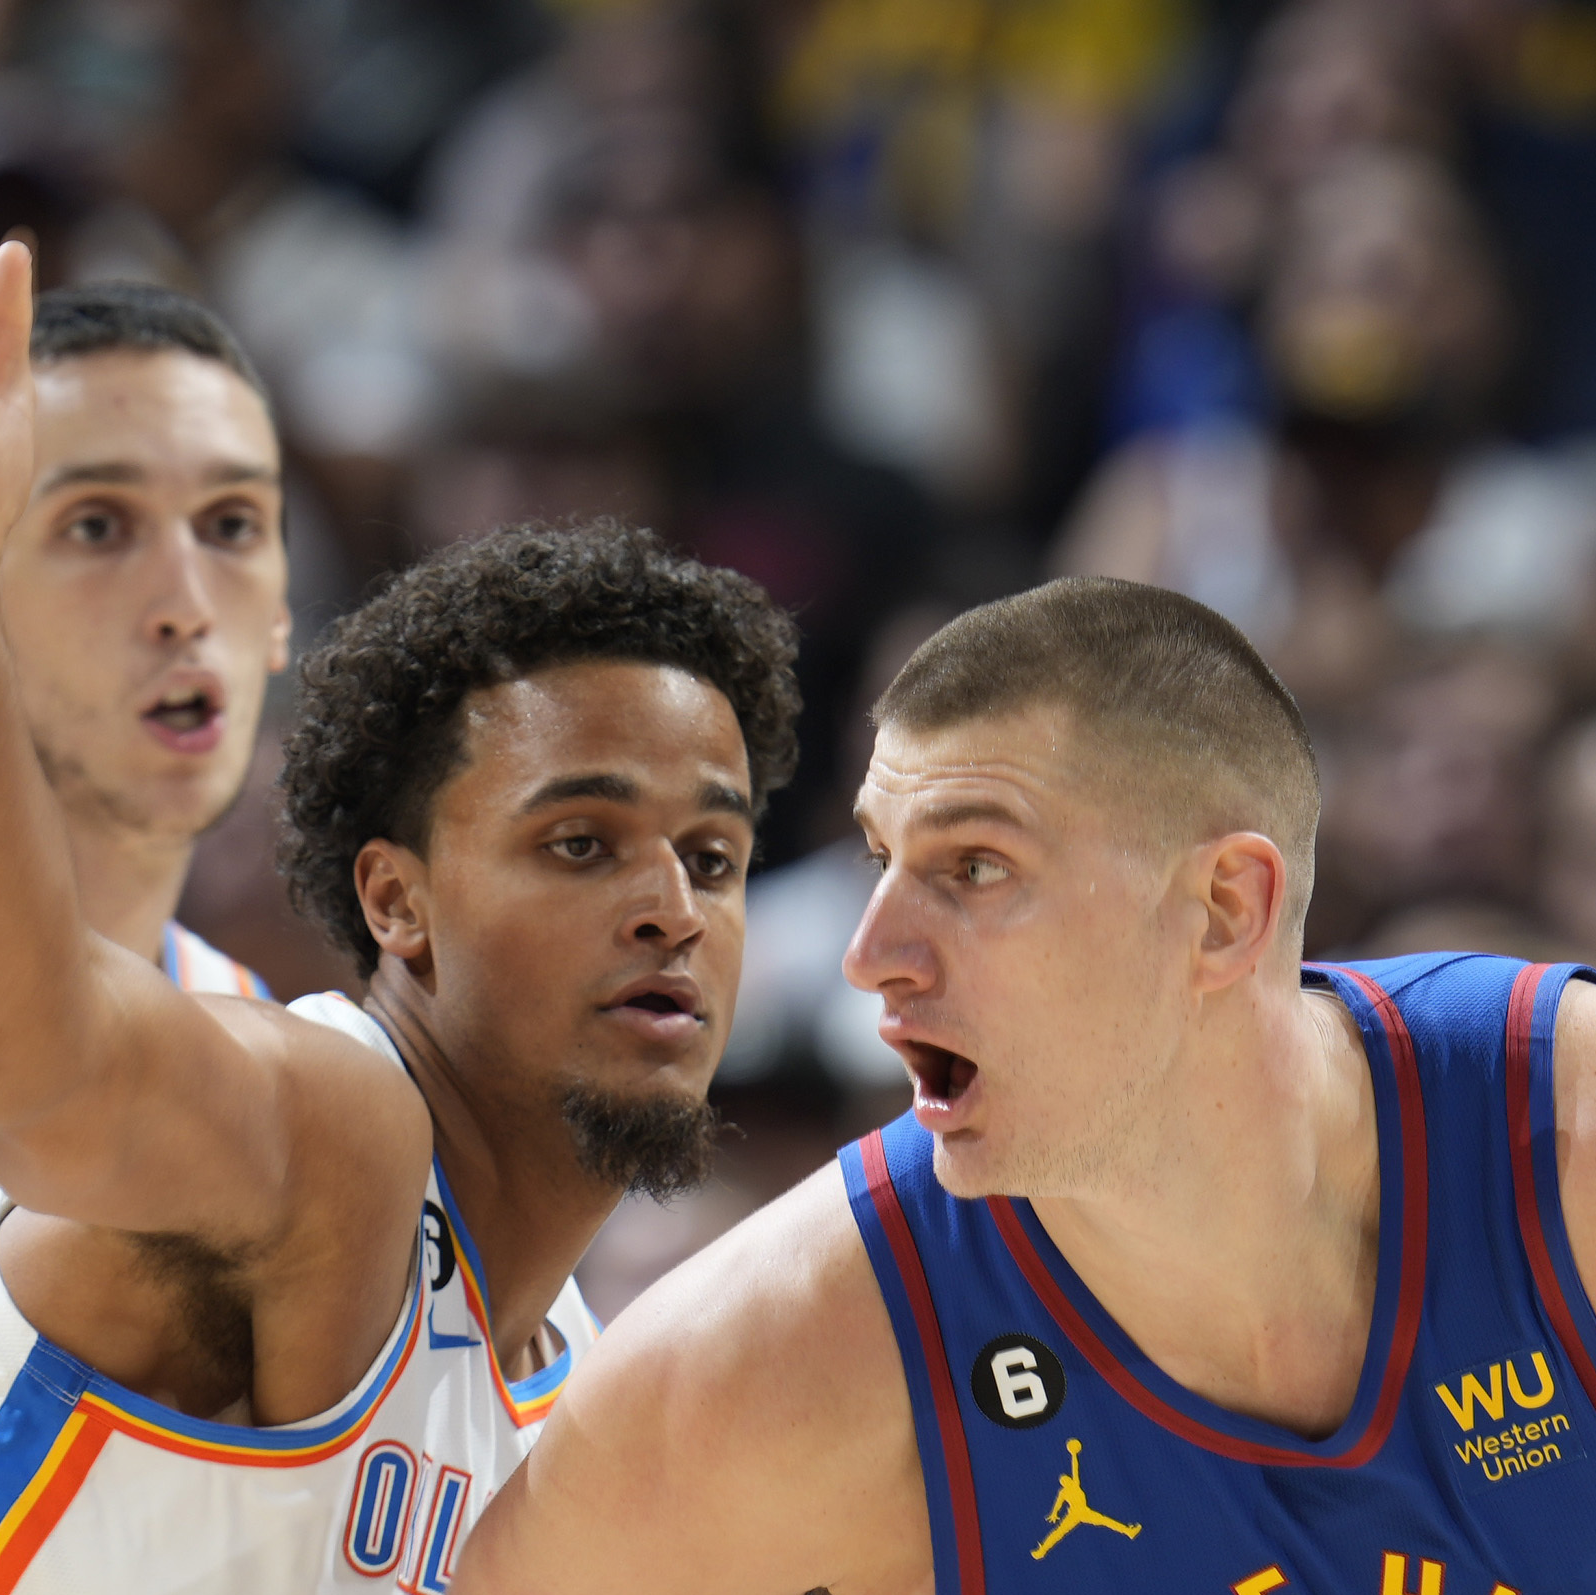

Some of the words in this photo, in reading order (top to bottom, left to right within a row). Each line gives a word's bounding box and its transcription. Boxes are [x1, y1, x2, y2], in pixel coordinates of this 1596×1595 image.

[991, 1345, 1048, 1418] 6
[1437, 1352, 1555, 1432] WU
[1455, 1415, 1570, 1463] Western
[1483, 1443, 1561, 1481] Union
